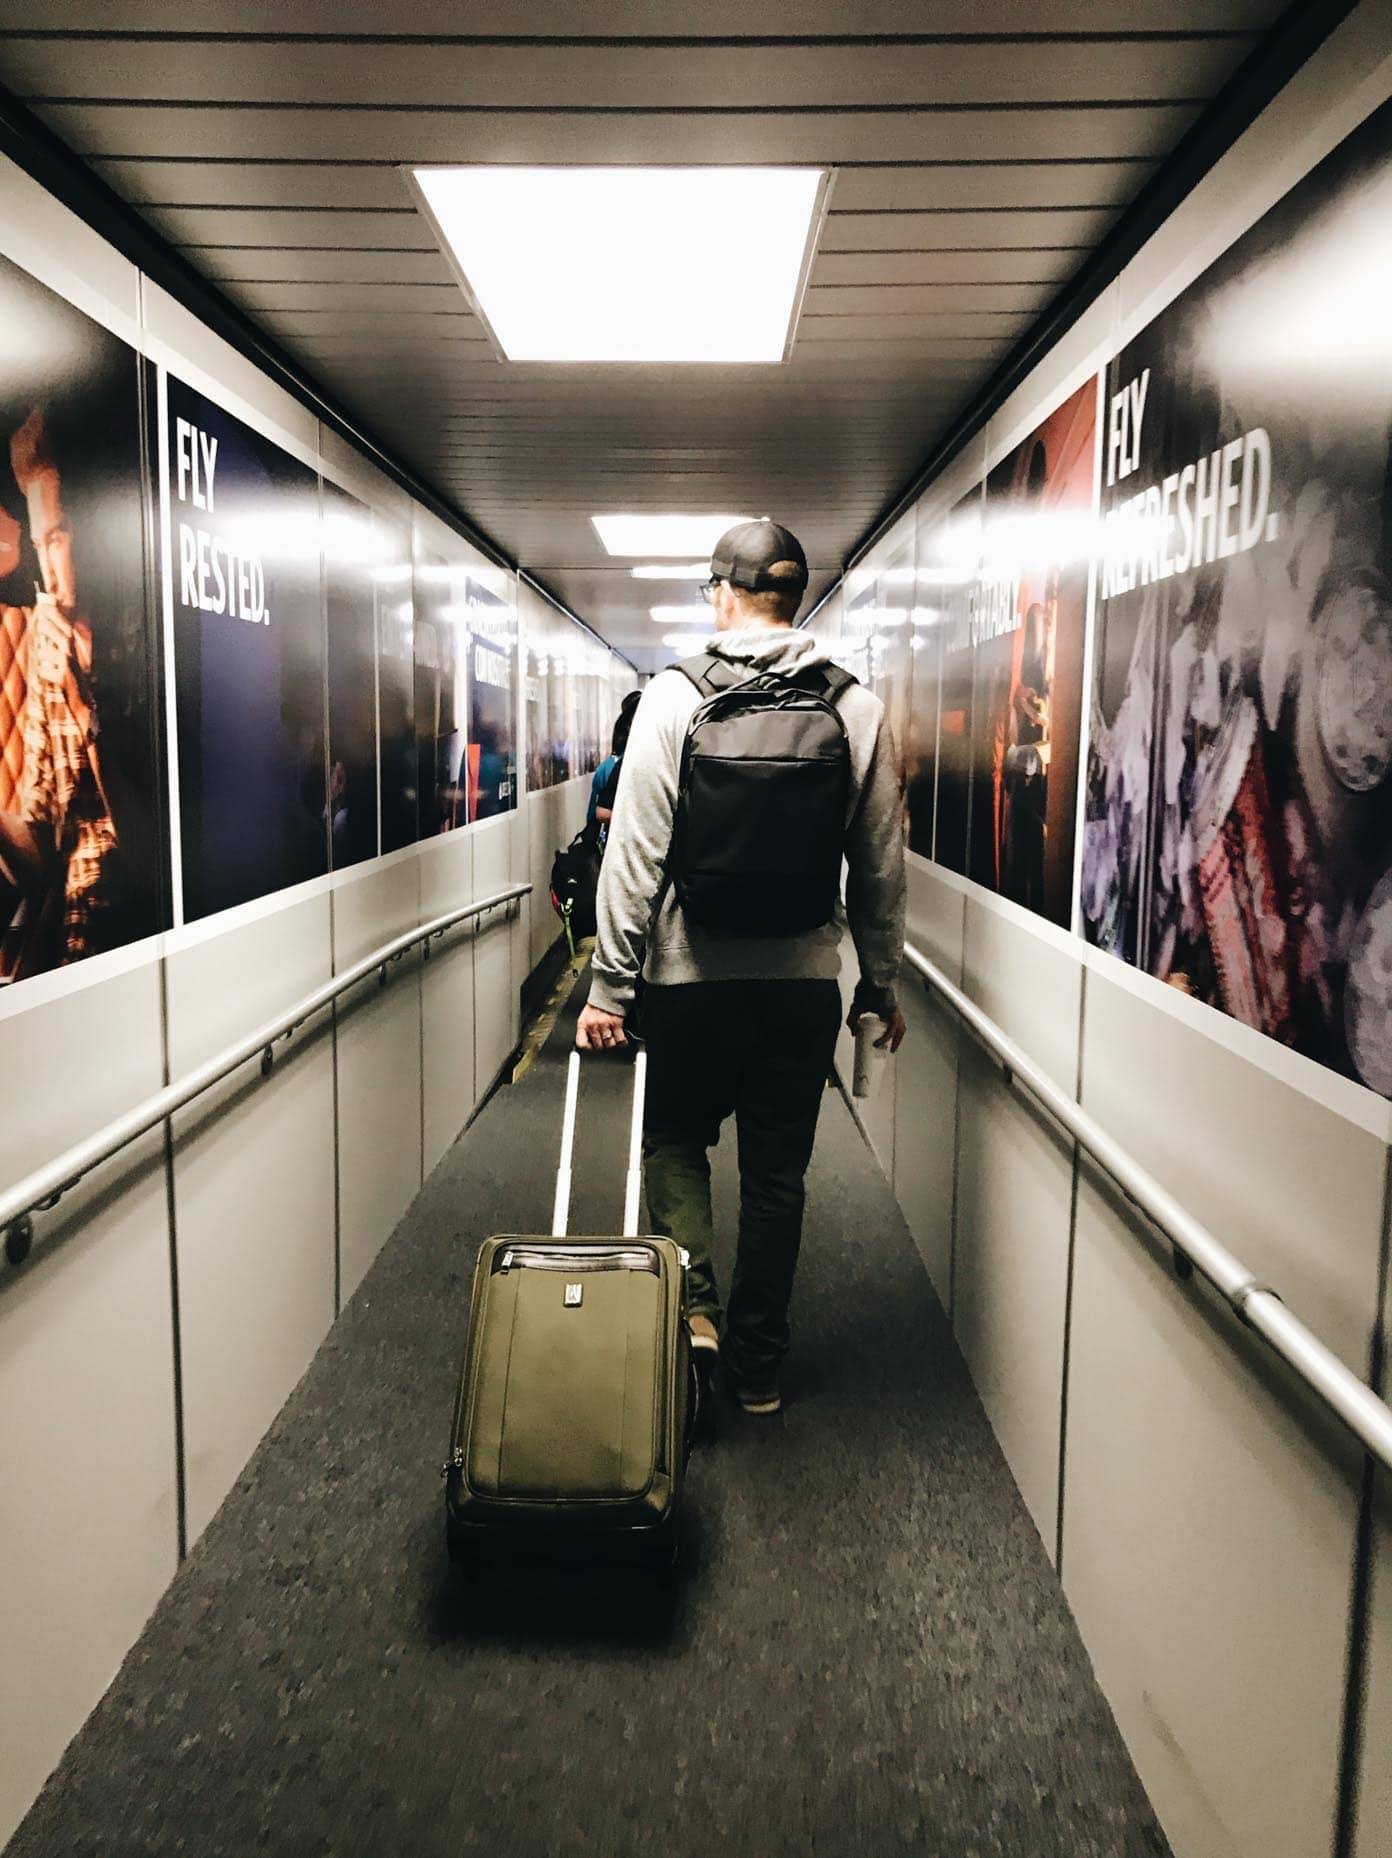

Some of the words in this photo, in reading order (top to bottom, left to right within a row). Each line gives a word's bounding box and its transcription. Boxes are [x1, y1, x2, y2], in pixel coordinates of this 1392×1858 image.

[176, 416, 218, 513] FLY
[1107, 368, 1150, 487] FLY
[179, 522, 270, 626] RESTED.
